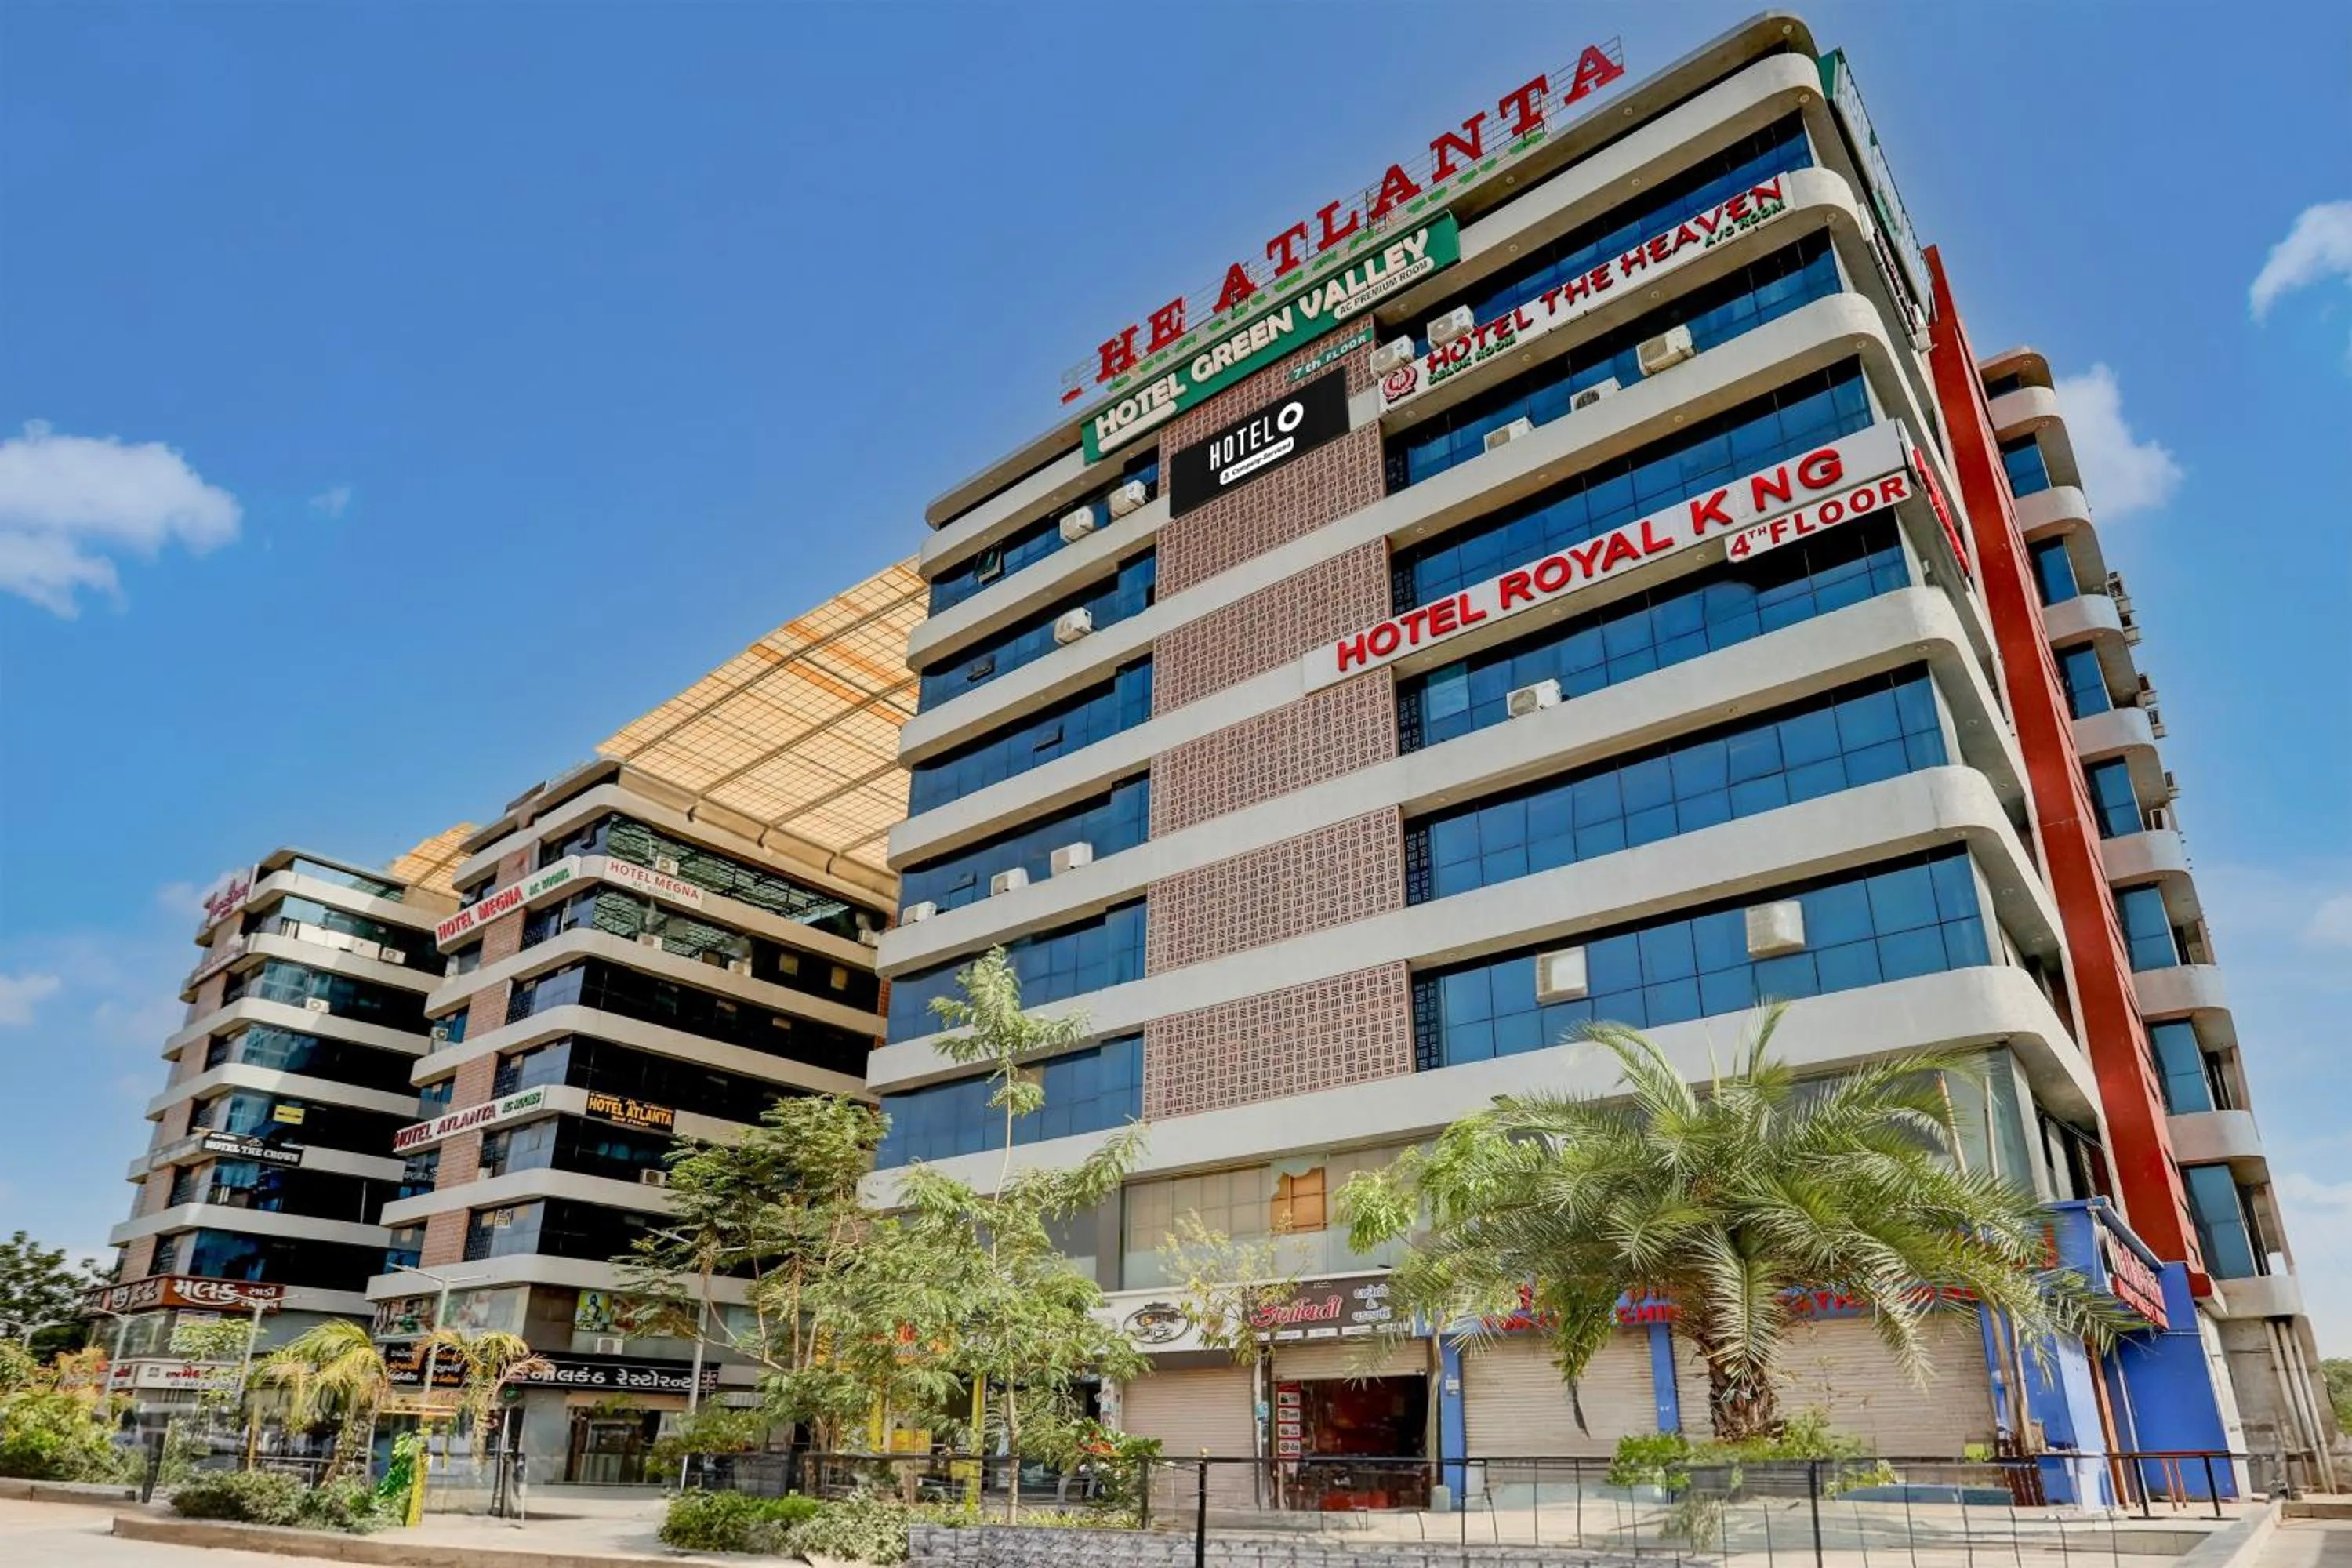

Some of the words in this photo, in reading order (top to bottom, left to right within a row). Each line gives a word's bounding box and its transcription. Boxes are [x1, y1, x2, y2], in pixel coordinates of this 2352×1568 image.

[1213, 45, 1625, 314] ATLANTA
[1739, 200, 1786, 232] ROOM
[1339, 303, 1353, 315] AC
[1354, 278, 1398, 307] PREMIUM
[1399, 260, 1428, 281] ROOM
[1427, 307, 1534, 375] HOTEL
[1541, 263, 1614, 316] THE
[1620, 176, 1784, 278] HEAVEN
[1095, 372, 1187, 441] HOTEL
[1191, 306, 1294, 383] GREEN
[1298, 228, 1429, 320] VALLEY
[1325, 335, 1367, 362] FLOOR
[1475, 334, 1517, 362] ROOM
[1210, 416, 1275, 470] HOTEL
[1770, 476, 1907, 545] FLOOR
[1337, 593, 1487, 672] HOTEL
[1499, 520, 1675, 611] ROYAL
[1690, 448, 1844, 535] KNG
[610, 862, 652, 883] HOTEL
[655, 877, 699, 900] MEGNA
[438, 910, 474, 941] HOTEL
[477, 885, 524, 922] MEGNA
[393, 1123, 433, 1149] HOTEL
[437, 1105, 497, 1134] ATLANTA
[588, 1097, 625, 1116] HOTEL
[626, 1103, 673, 1127] ATLANTA
[205, 1139, 241, 1154] HOTEL
